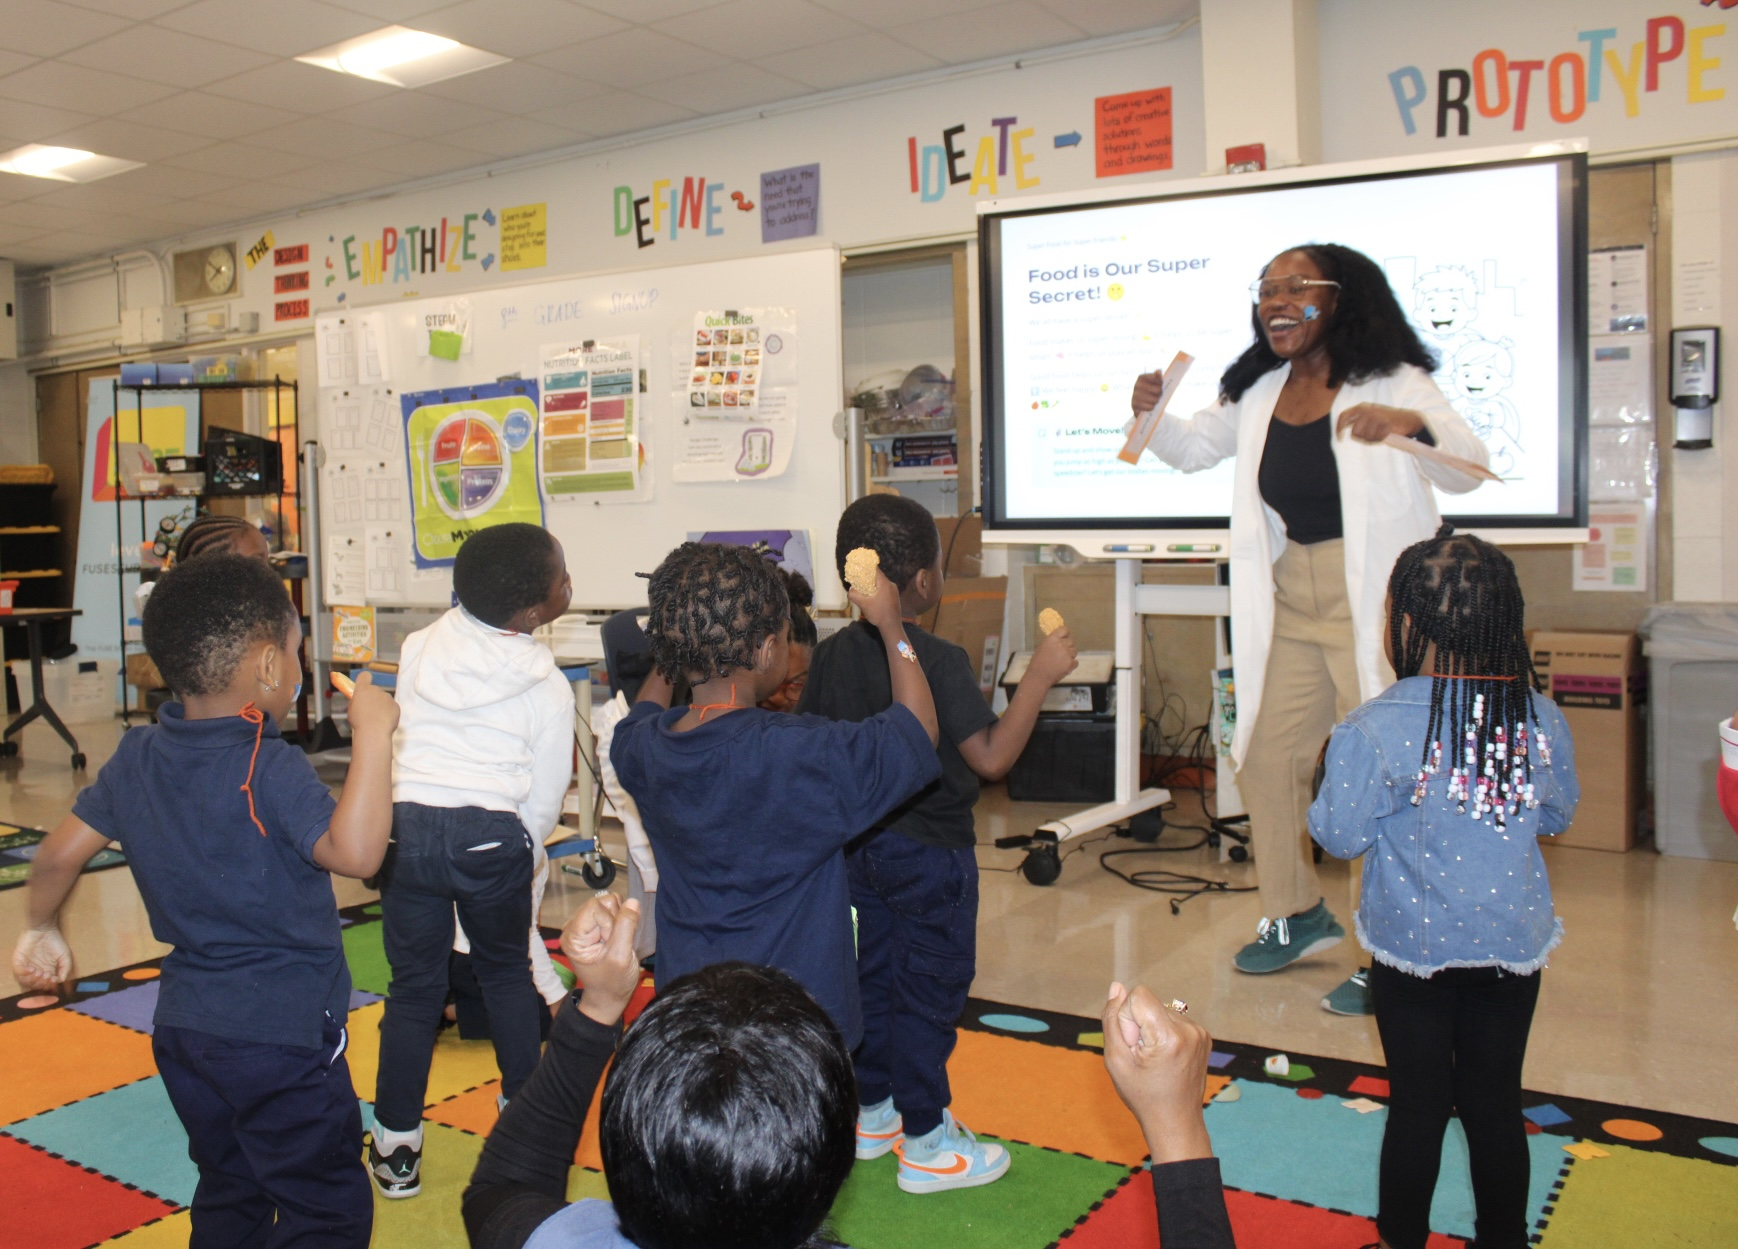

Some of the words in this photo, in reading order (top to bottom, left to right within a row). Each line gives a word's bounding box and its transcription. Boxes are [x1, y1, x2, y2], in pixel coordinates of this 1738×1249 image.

[1388, 15, 1727, 138] PROTOTYPE
[1103, 100, 1128, 112] Come
[1131, 100, 1142, 108] up
[1145, 93, 1165, 105] with
[1104, 116, 1120, 126] lots
[1124, 111, 1134, 123] of
[1136, 109, 1169, 121] creative
[1103, 127, 1141, 140] solutions
[1104, 140, 1140, 154] through
[908, 116, 1040, 203] IDEATE
[1104, 156, 1122, 168] and
[764, 174, 786, 187] What
[790, 174, 796, 182] is
[800, 170, 814, 180] the
[764, 188, 783, 201] need
[786, 183, 802, 195] that
[787, 196, 811, 209] trying
[502, 211, 520, 223] Learn
[614, 176, 724, 249] DEFINE
[766, 219, 775, 228] to
[247, 236, 269, 264] THE
[275, 247, 303, 264] DESIGN
[343, 213, 478, 286] EMPATHIZE
[1028, 266, 1078, 283] Food
[1083, 264, 1100, 278] is
[1105, 262, 1143, 276] Our
[1147, 256, 1211, 273] Super
[275, 271, 308, 290] THINKING
[1029, 286, 1101, 305] Secret!
[275, 300, 307, 318] PROCESS
[534, 301, 583, 326] GRADE
[705, 315, 730, 328] Quick
[732, 314, 753, 326] Bites
[544, 356, 584, 369] NUTRITIO
[585, 354, 609, 366] FACTS
[610, 351, 633, 362] LABEL
[1065, 427, 1089, 436] Let's
[1093, 426, 1124, 435] Move!
[467, 477, 494, 487] Protein
